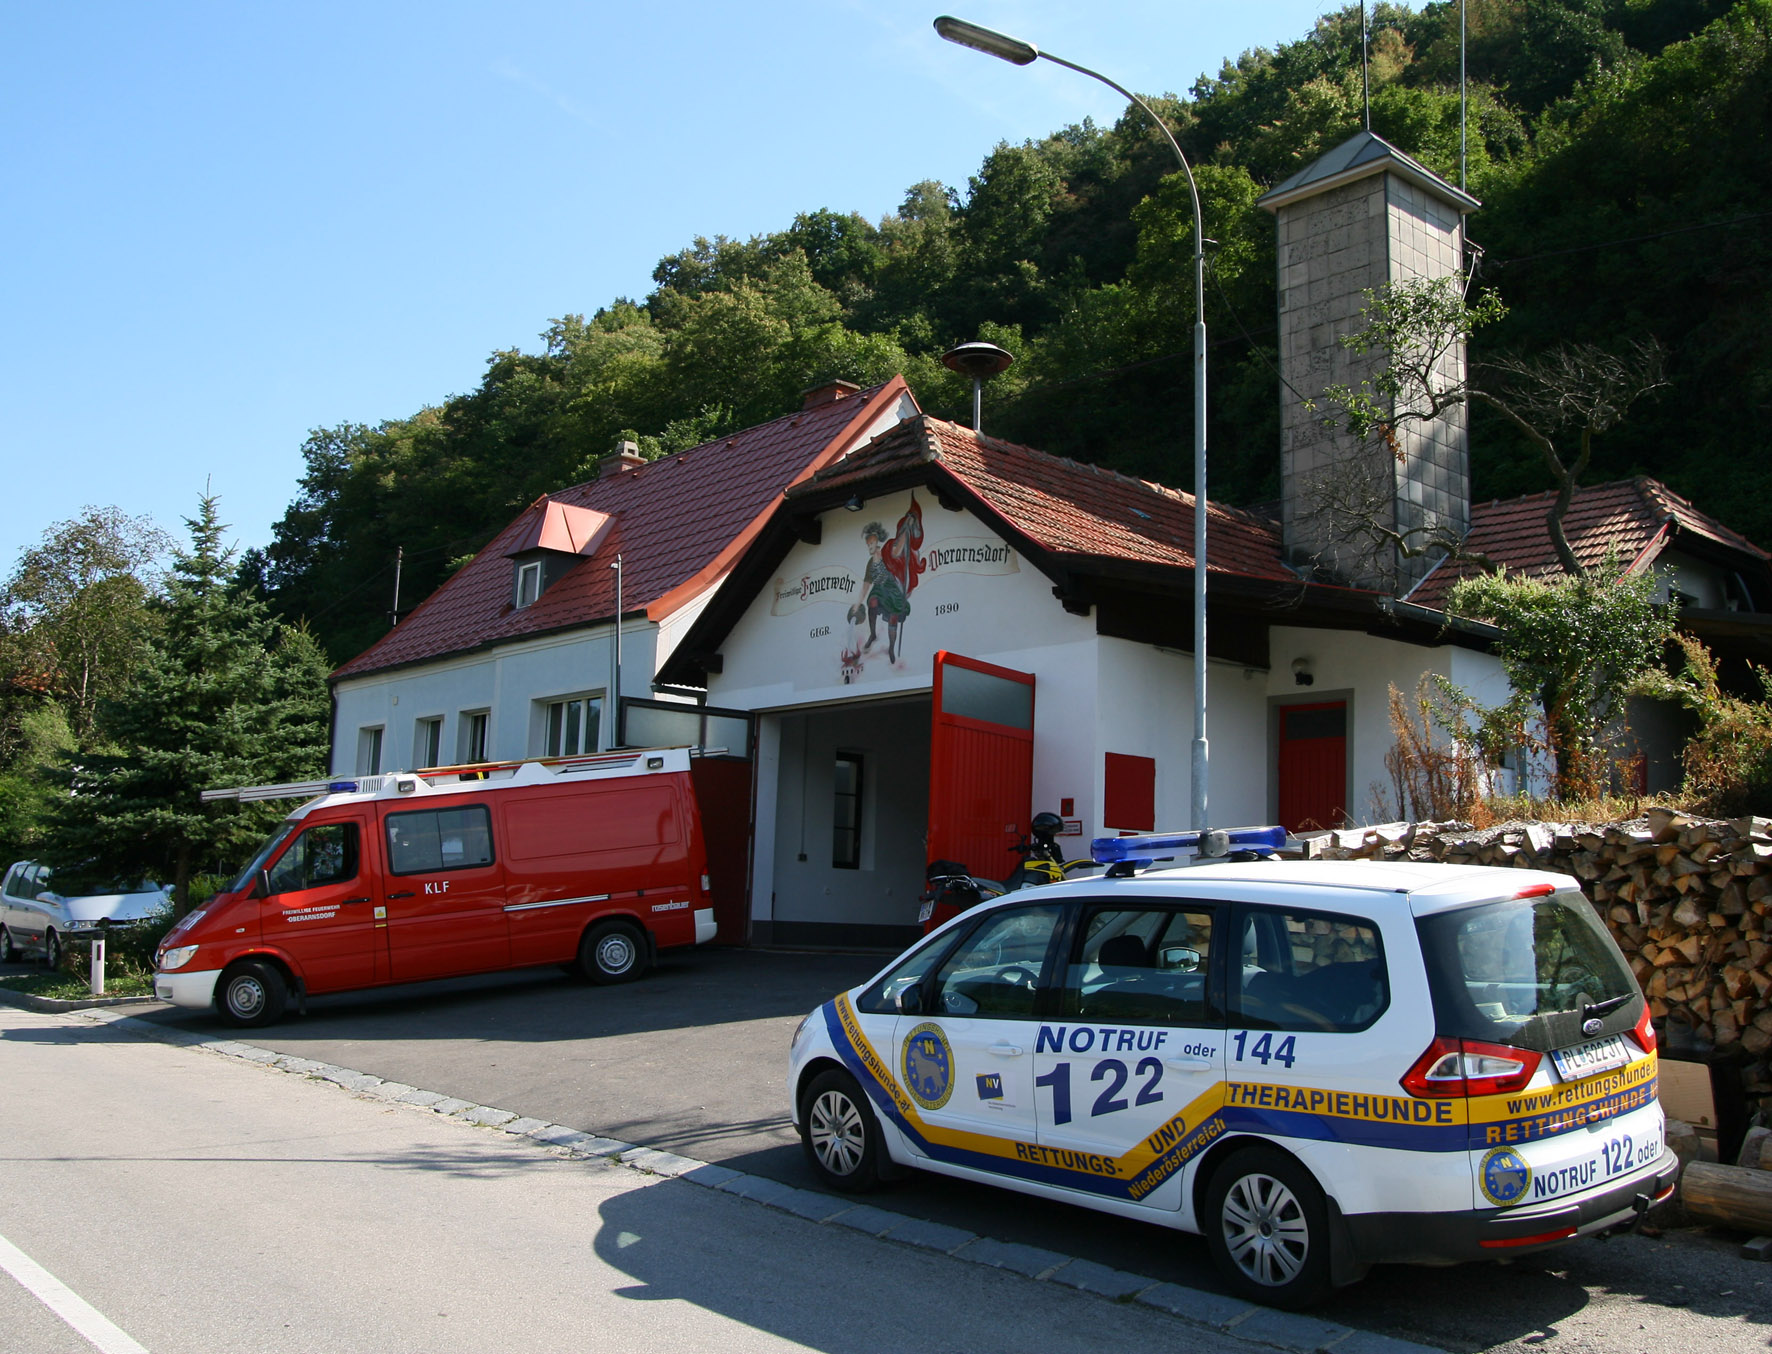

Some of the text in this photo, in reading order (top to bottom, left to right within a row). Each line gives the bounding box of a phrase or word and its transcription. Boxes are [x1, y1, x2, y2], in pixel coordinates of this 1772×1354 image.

[929, 544, 1010, 571] Oberarnsdorf
[800, 574, 856, 601] Feuerwehr
[935, 602, 959, 616] 1890
[810, 625, 831, 639] GEGR.
[425, 881, 449, 894] KLF
[838, 997, 910, 1113] www.rettungshunde.at
[924, 1039, 936, 1055] N
[1035, 1025, 1296, 1069] NOTRUF oder 144
[1563, 1049, 1581, 1071] PL
[985, 1078, 999, 1089] NV
[1036, 1056, 1164, 1126] 122
[1508, 1060, 1657, 1115] www.rettungshunde.a
[1228, 1083, 1453, 1123] THERAPIEHUNDE
[1486, 1088, 1646, 1144] RETTUNGSHUNDE
[1015, 1116, 1186, 1176] RETTUNGS- UND
[1127, 1117, 1227, 1200] Niederösterreich
[1500, 1157, 1513, 1169] N
[1534, 1159, 1597, 1198] NOTRUF
[1601, 1134, 1634, 1176] 122
[1637, 1140, 1658, 1163] oder
